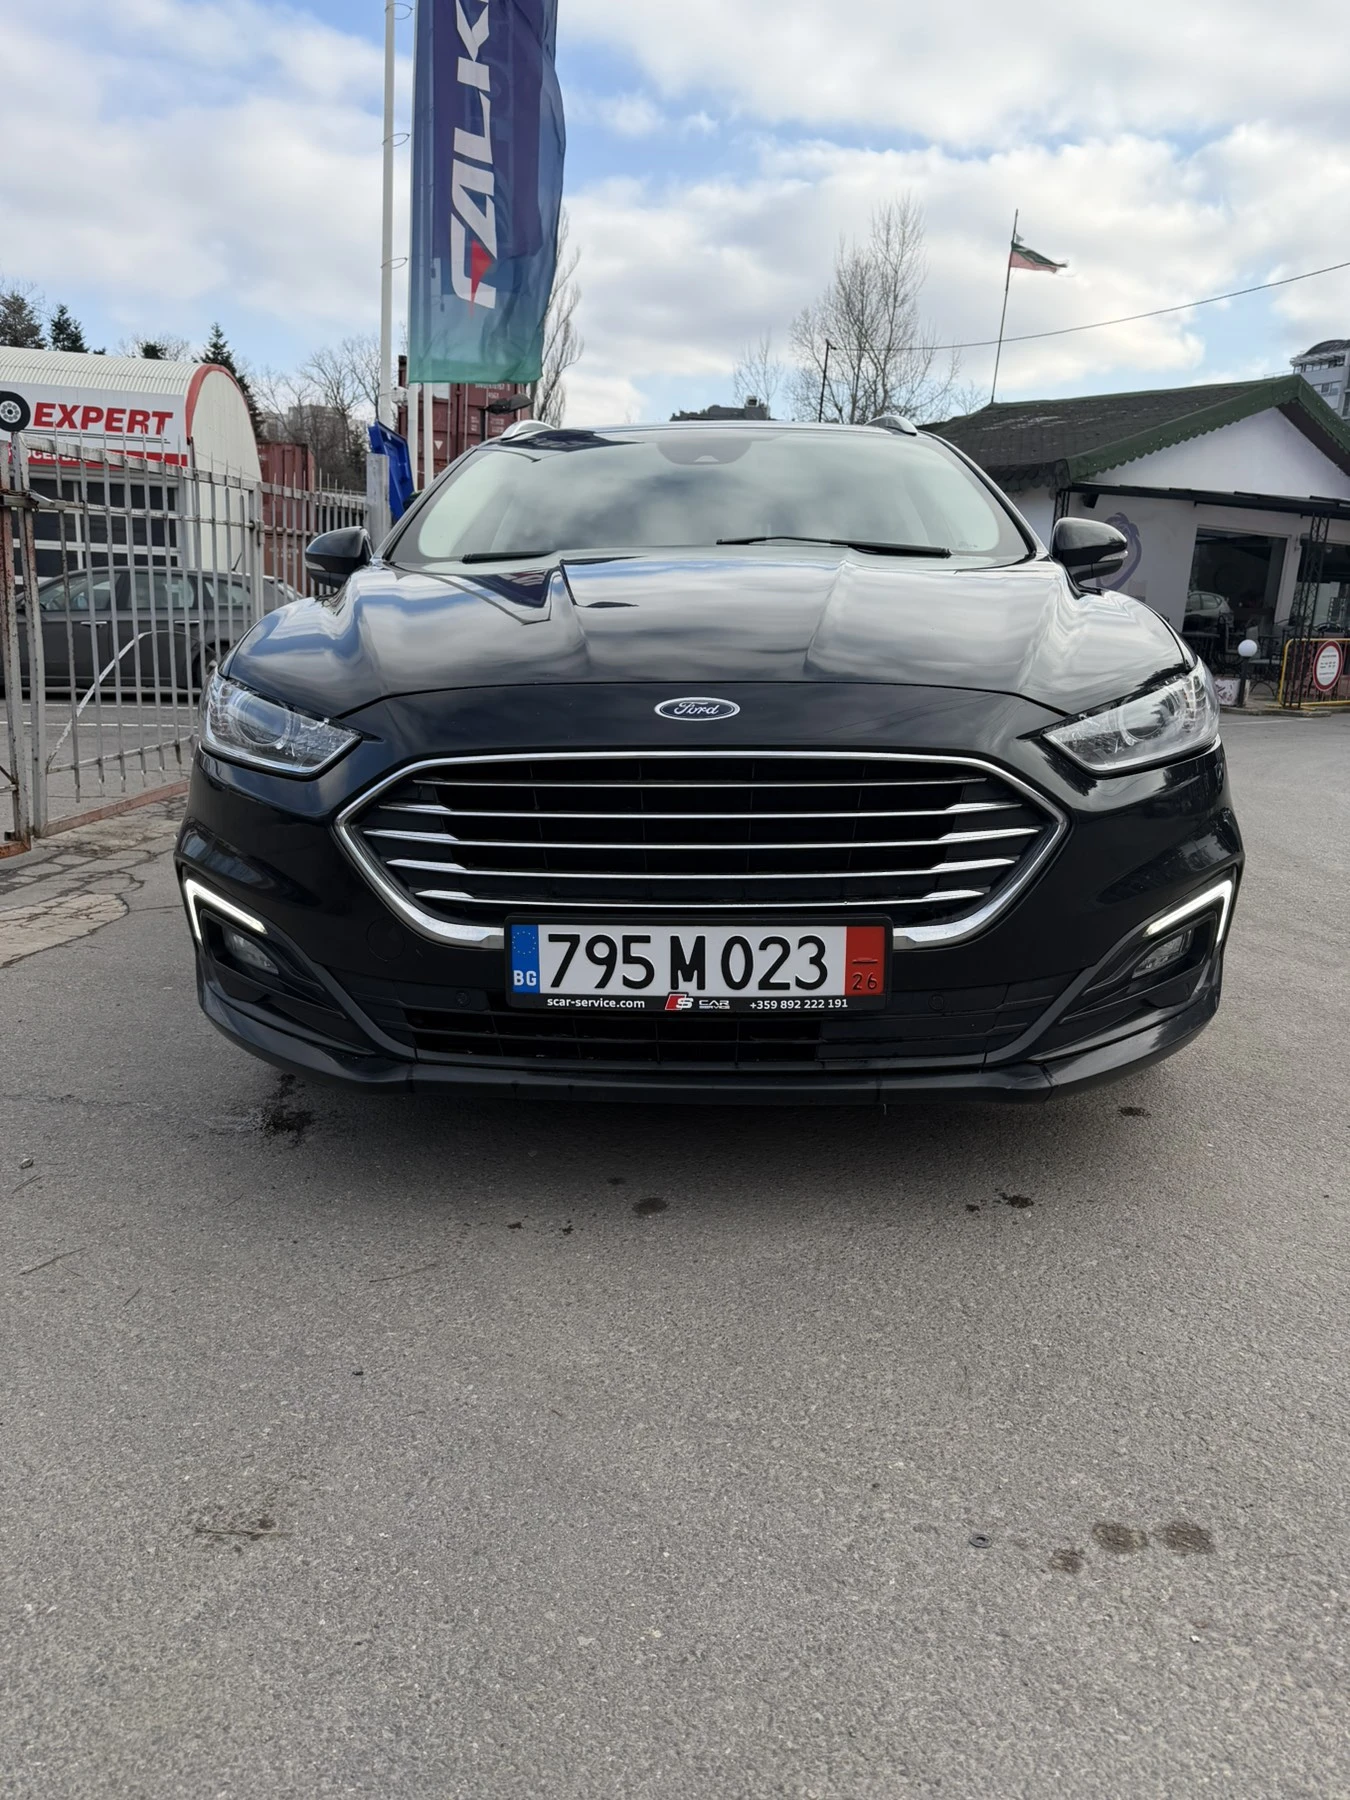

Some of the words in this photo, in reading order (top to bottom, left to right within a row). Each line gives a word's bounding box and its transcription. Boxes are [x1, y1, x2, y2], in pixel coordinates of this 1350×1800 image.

[451, 0, 497, 309] FALK
[33, 402, 174, 435] EXPERT
[673, 701, 720, 715] Ford
[548, 933, 655, 990] 795
[670, 935, 706, 991] M
[720, 935, 828, 991] 023
[513, 970, 537, 986] BG
[852, 972, 878, 991] 26
[547, 997, 645, 1009] scar-service.com
[750, 1000, 778, 1010] +359
[780, 1000, 801, 1010] 892
[804, 1000, 825, 1009] 222
[828, 999, 848, 1009] 191
